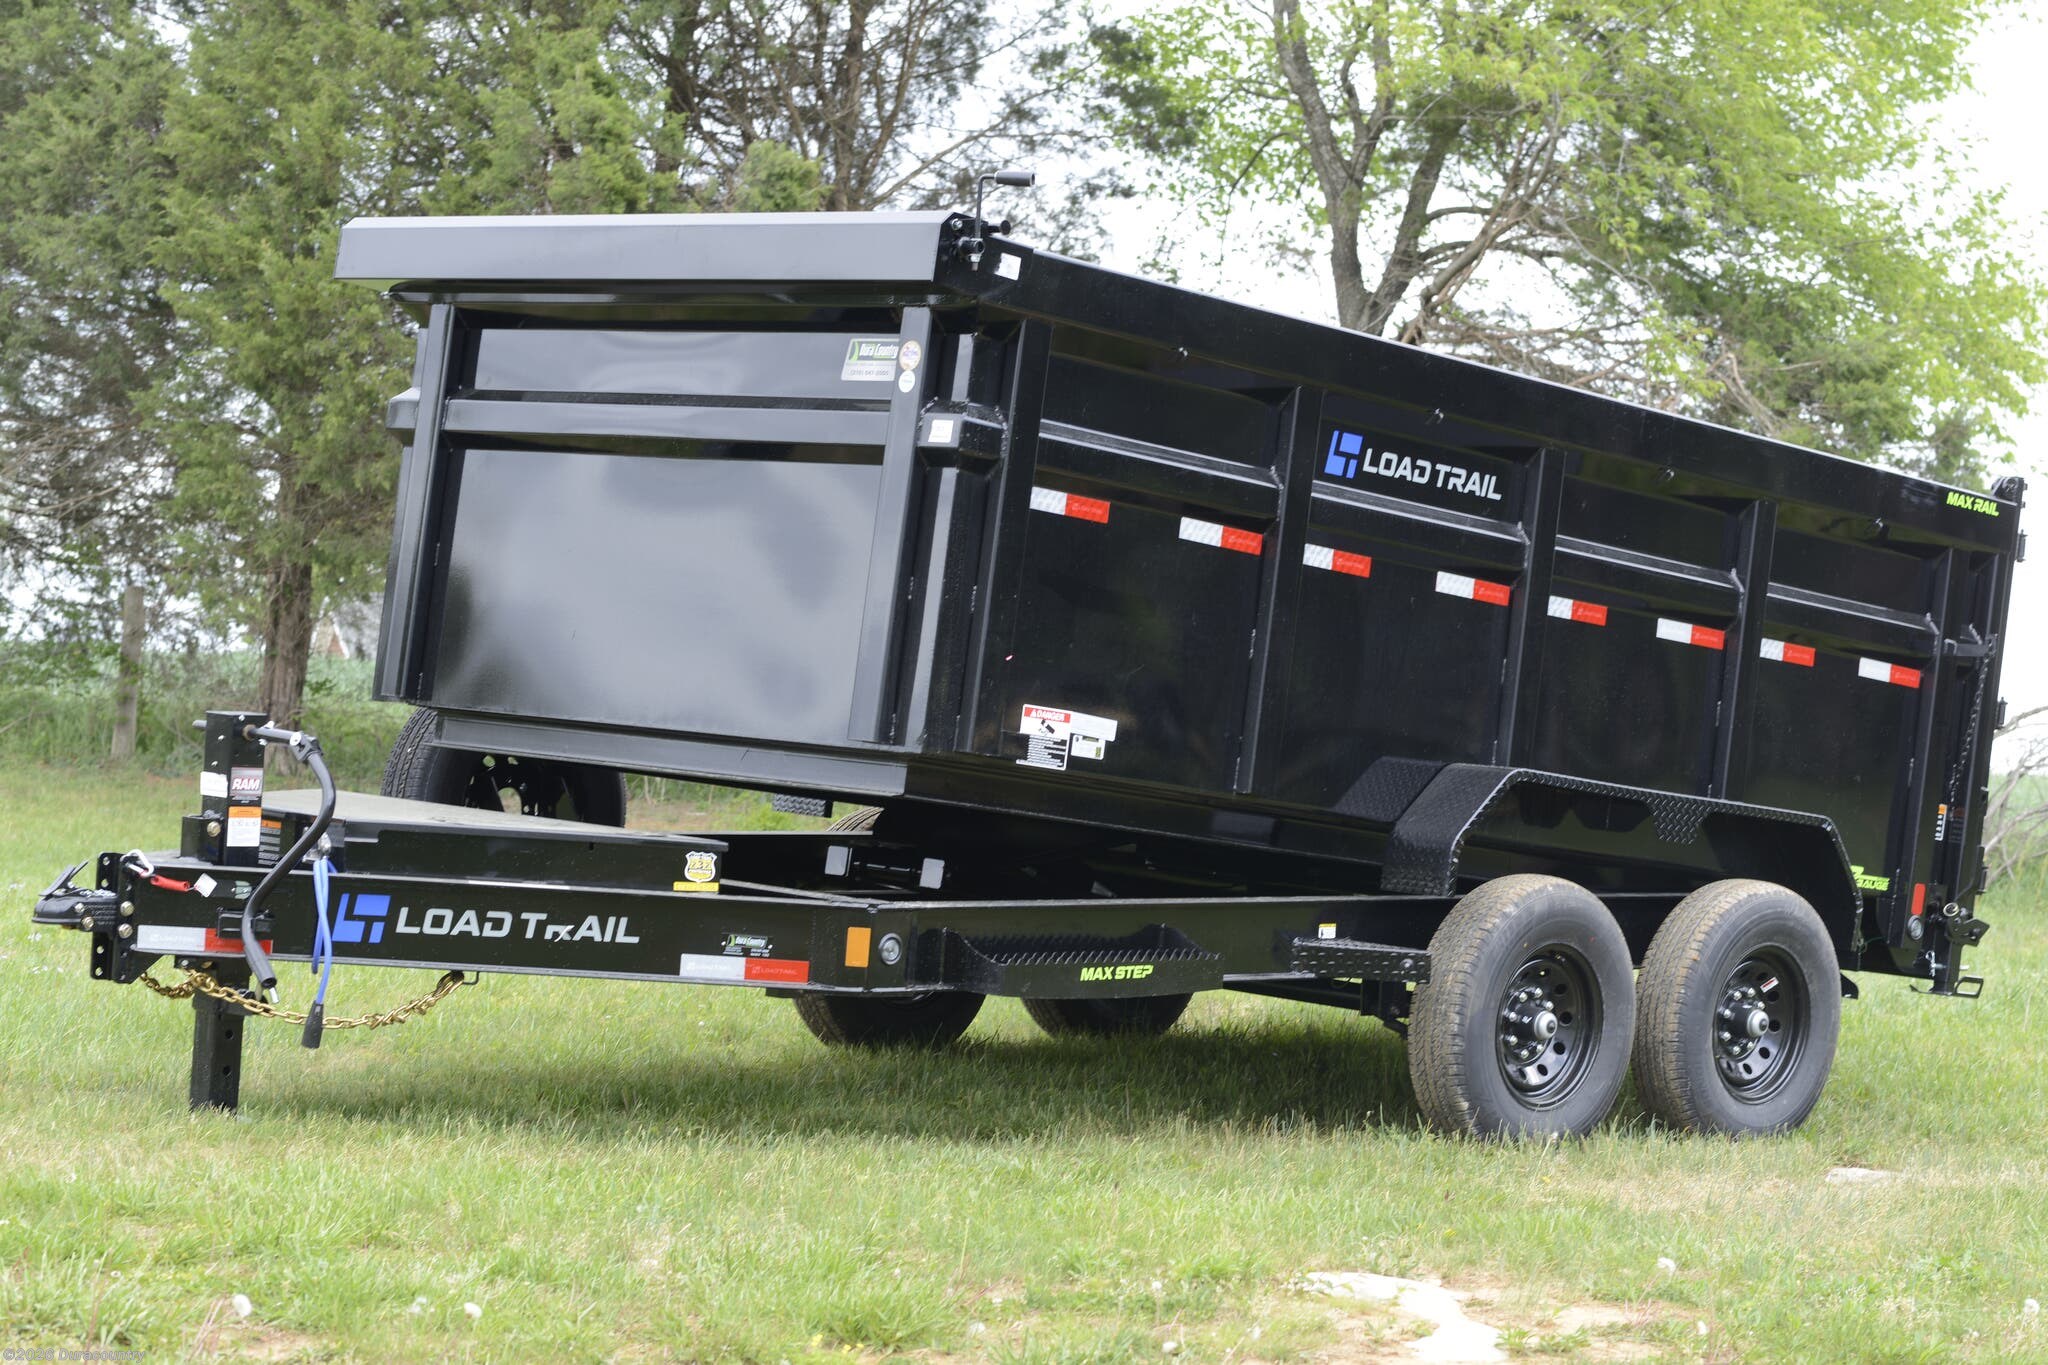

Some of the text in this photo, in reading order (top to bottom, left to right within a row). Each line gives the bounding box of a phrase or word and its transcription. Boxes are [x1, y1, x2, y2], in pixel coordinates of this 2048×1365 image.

[1946, 491, 2000, 517] MAX RAIL
[1036, 710, 1065, 721] DANGER
[232, 778, 260, 791] RAM
[395, 906, 513, 938] LOAD
[1080, 964, 1154, 981] MAX STEP
